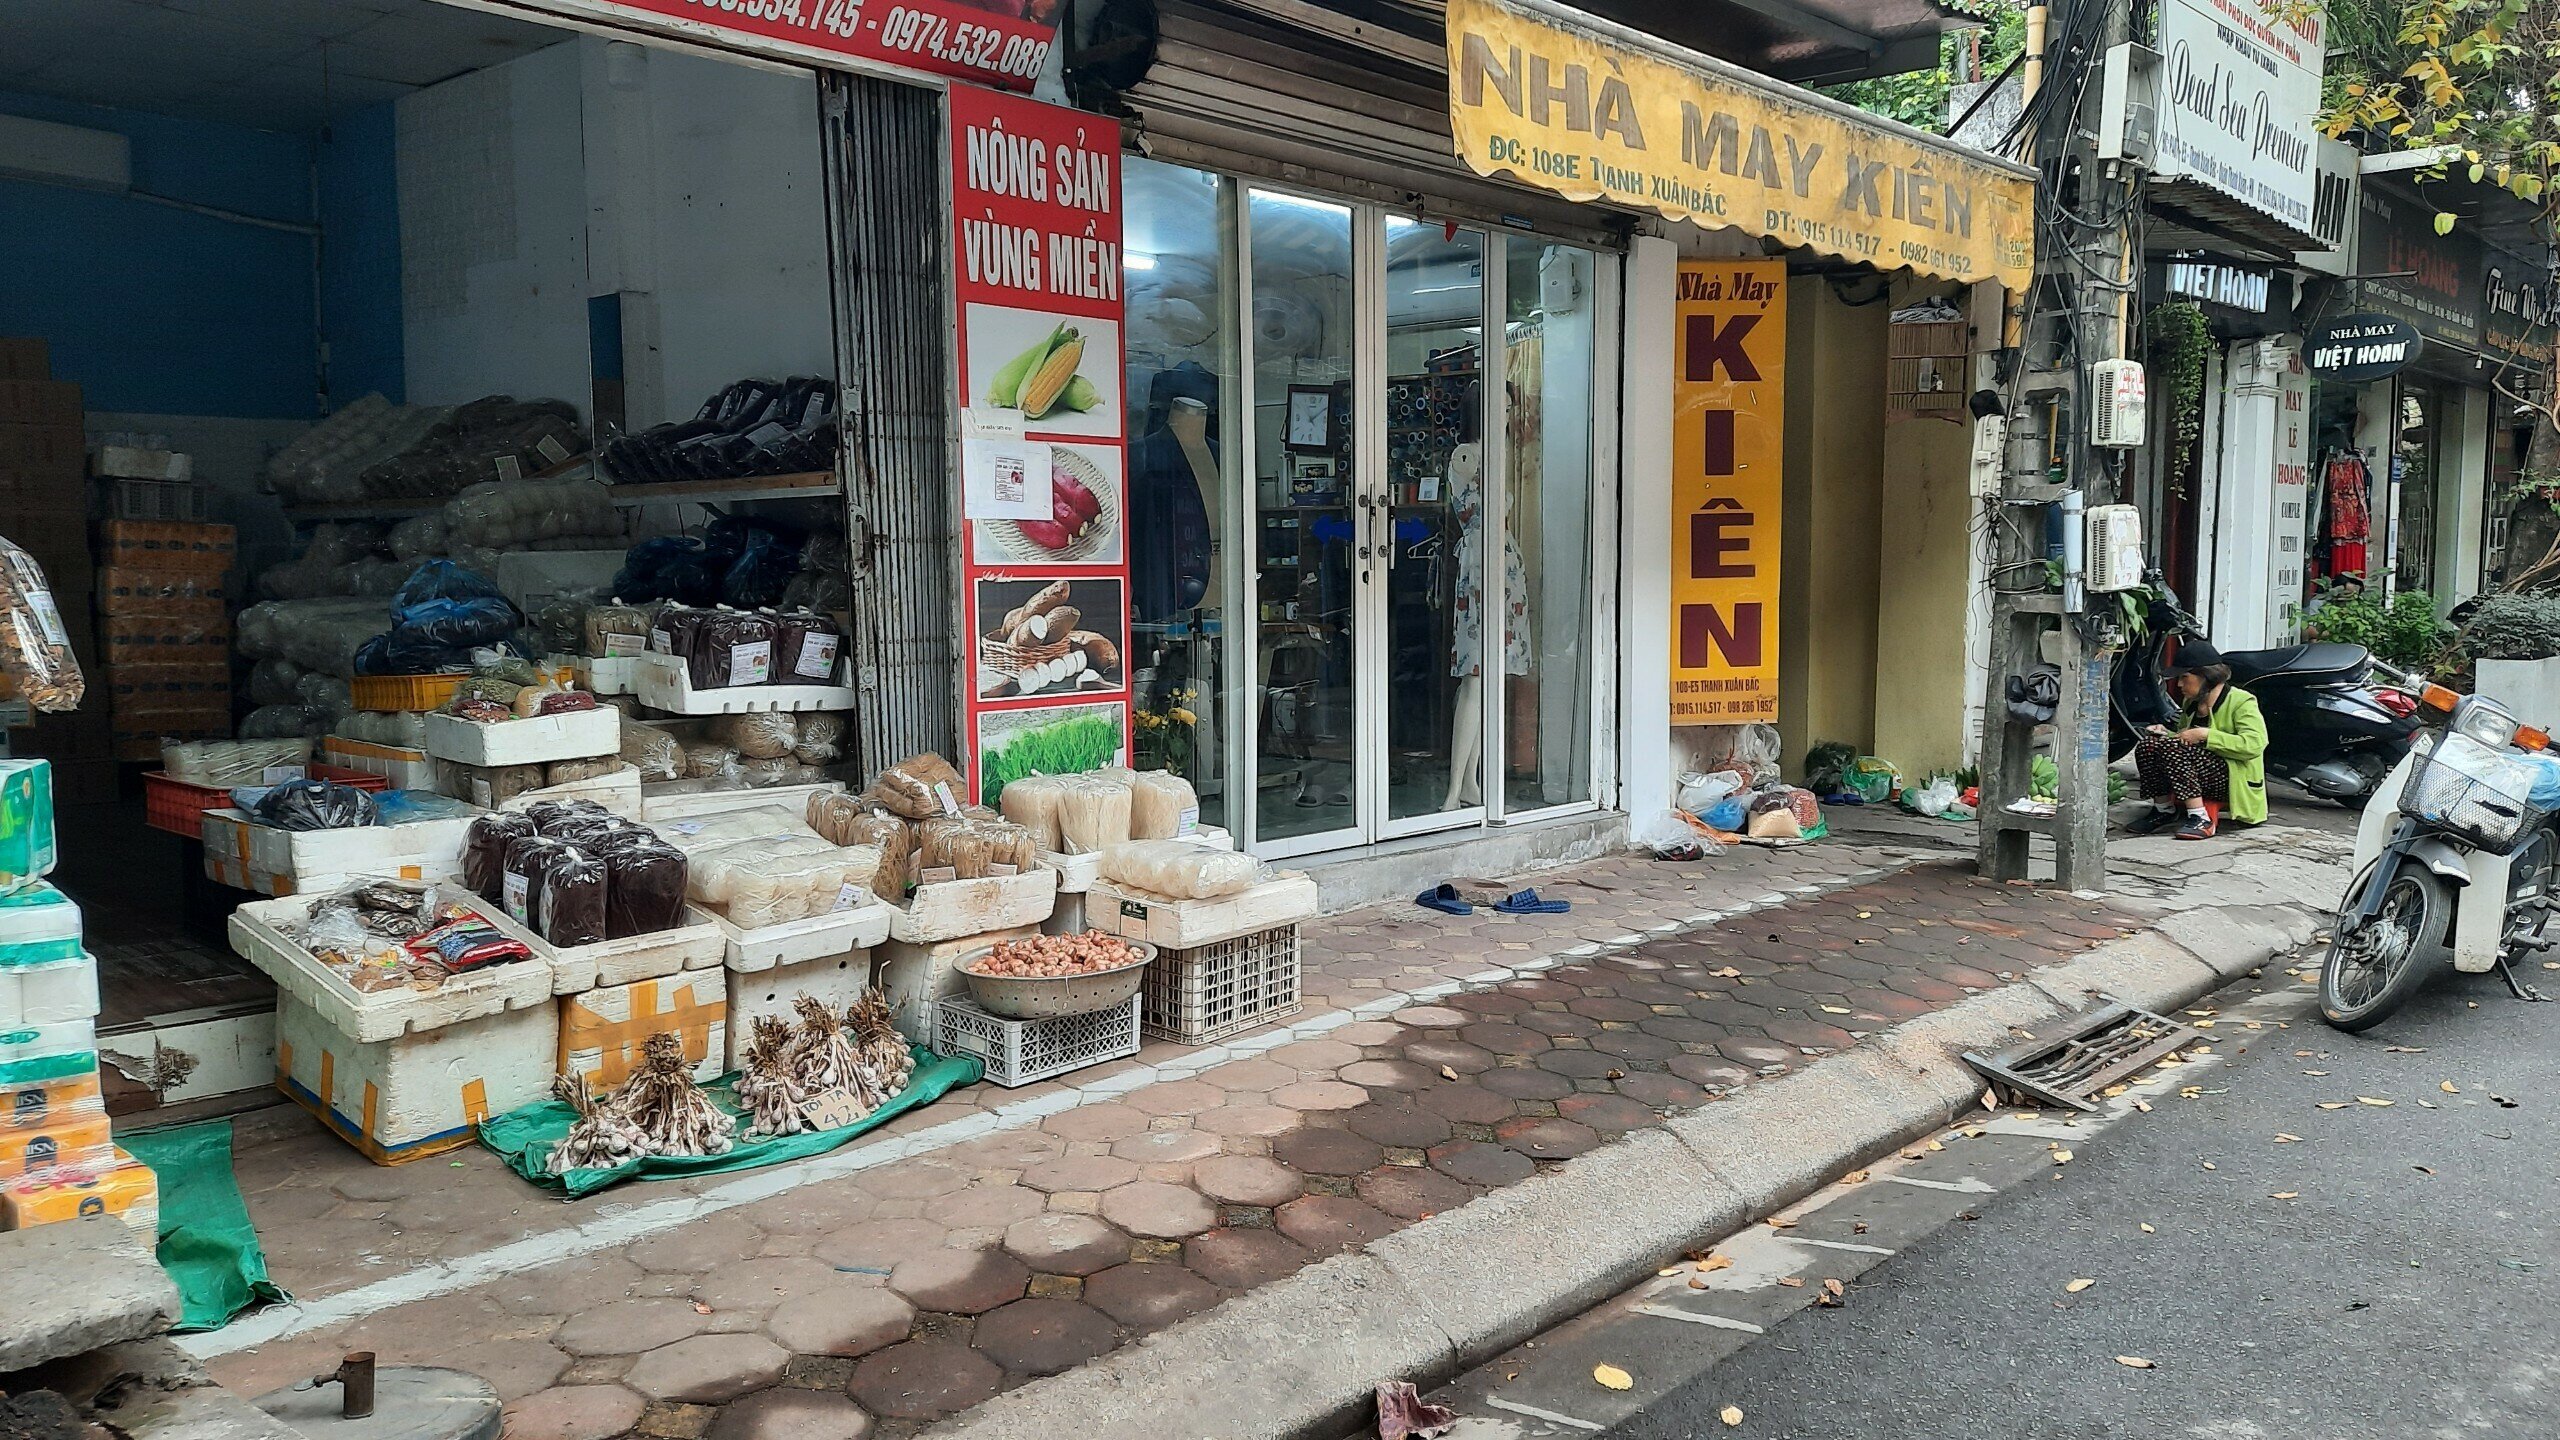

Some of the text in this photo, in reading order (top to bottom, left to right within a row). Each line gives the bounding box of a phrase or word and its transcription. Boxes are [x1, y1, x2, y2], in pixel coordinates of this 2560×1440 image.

[881, 6, 1050, 80] 0974.532.088
[2171, 39, 2309, 175] Dead Sea Premier
[1461, 32, 1972, 240] NHÀ MAY KIÊN
[967, 116, 1110, 214] NÔNG SẢN
[1489, 135, 1526, 167] ĐC:
[1532, 146, 1581, 180] 108E
[1589, 156, 1644, 196] TANH
[962, 207, 1118, 302] VÙNG MIỀN
[1830, 225, 1852, 250] 114
[1855, 234, 1882, 256] 517
[1900, 240, 1928, 264] 0982
[1948, 252, 1972, 274] 952
[1676, 271, 1780, 310] Nhà May
[2329, 323, 2397, 340] NHÀ MAY
[2313, 344, 2354, 371] VIỆT
[2285, 389, 2304, 412] MAY
[2288, 421, 2298, 449] LÊ
[2277, 458, 2306, 486] HOÀNG
[1701, 680, 1723, 693] THANH
[1724, 676, 1744, 692] XUÂN
[1745, 675, 1760, 692] BẮC
[1676, 701, 1722, 715] 0915.114.517
[1756, 700, 1773, 713] 1952
